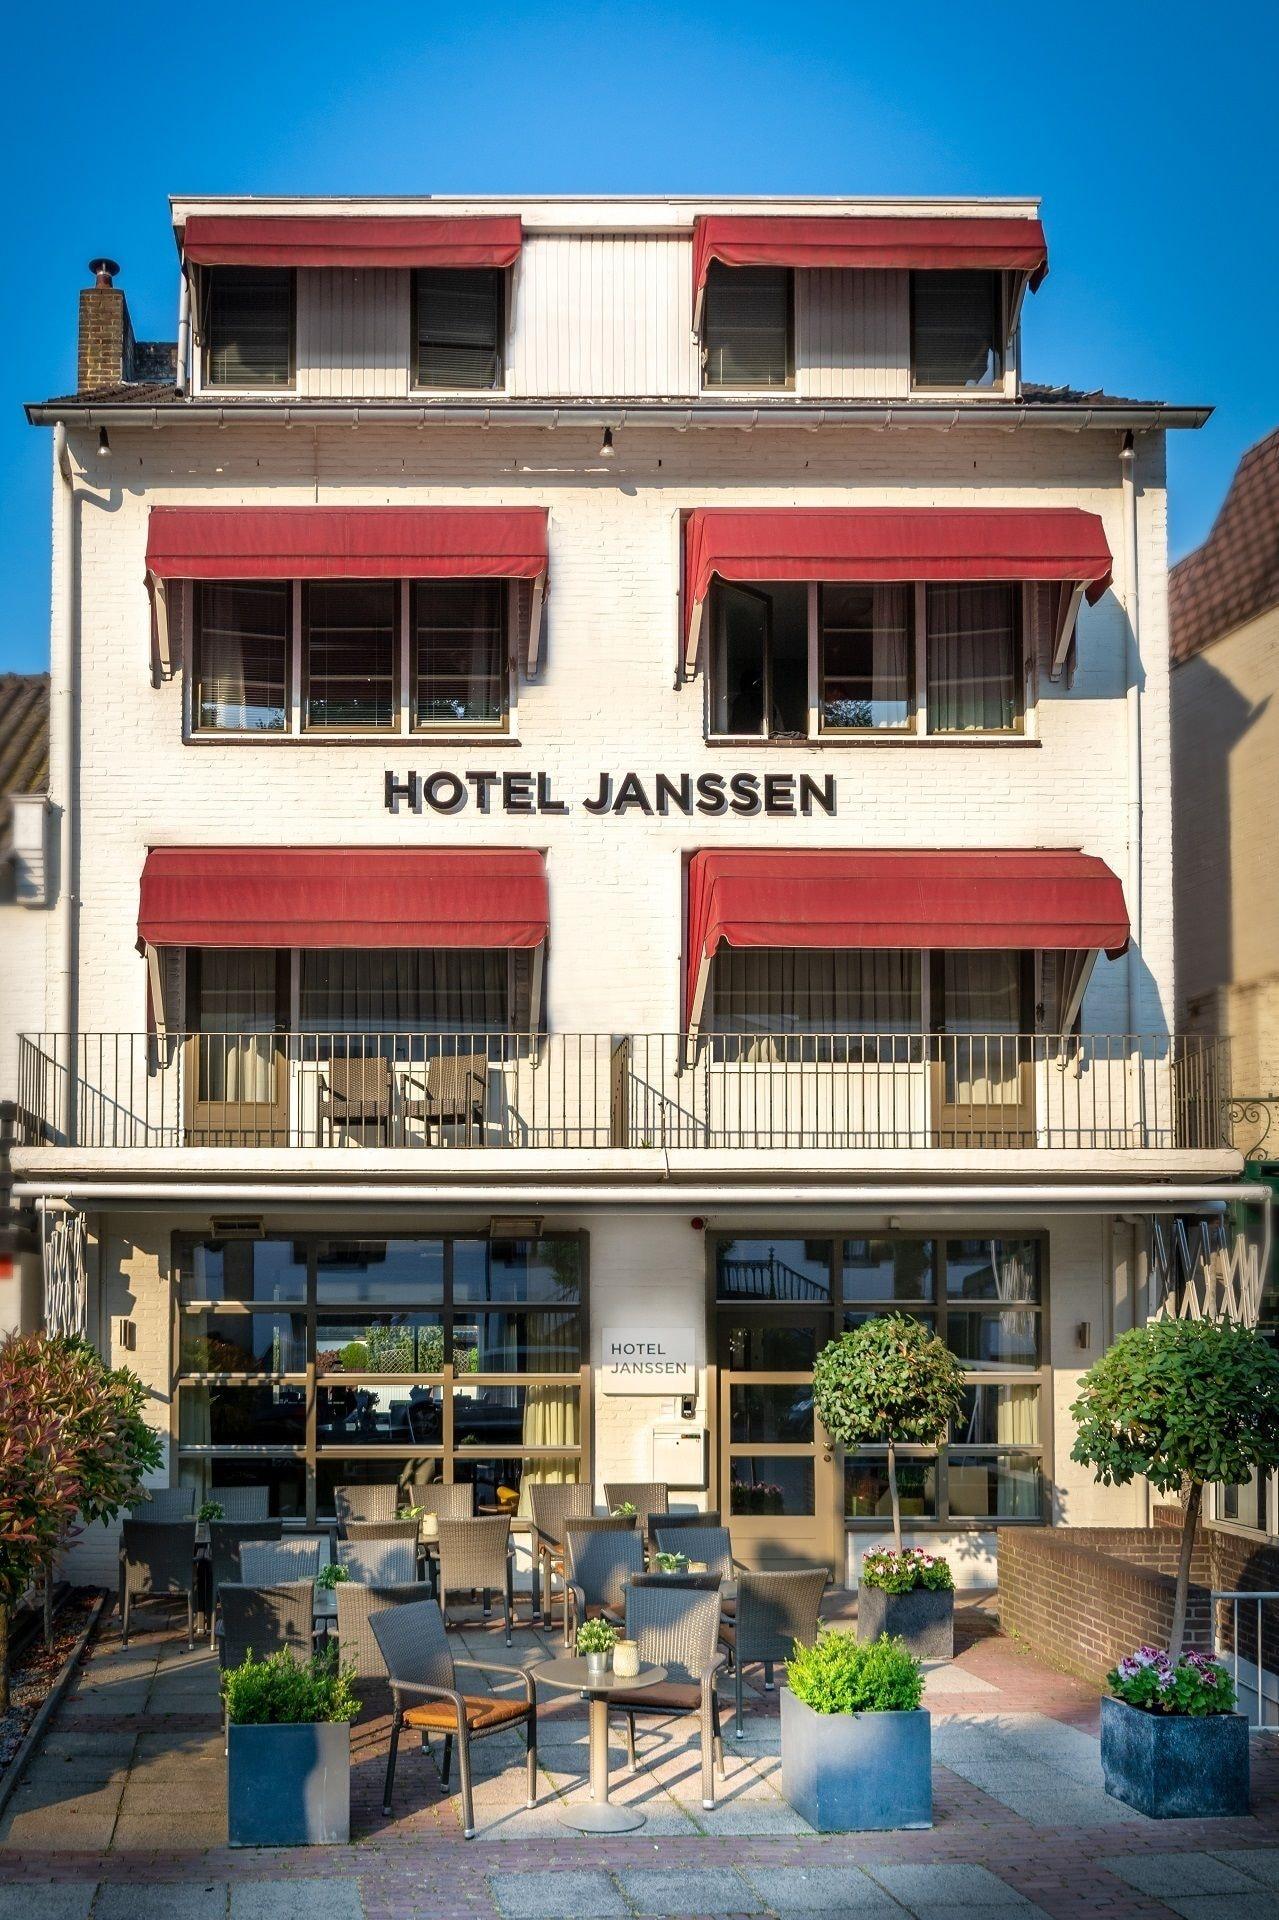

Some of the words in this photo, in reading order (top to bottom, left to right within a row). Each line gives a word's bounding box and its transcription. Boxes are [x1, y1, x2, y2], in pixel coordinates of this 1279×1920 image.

[384, 770, 567, 815] HOTEL
[582, 772, 836, 816] JANSSEN
[611, 1343, 666, 1355] HOTEL
[610, 1362, 687, 1374] JANSSEN
